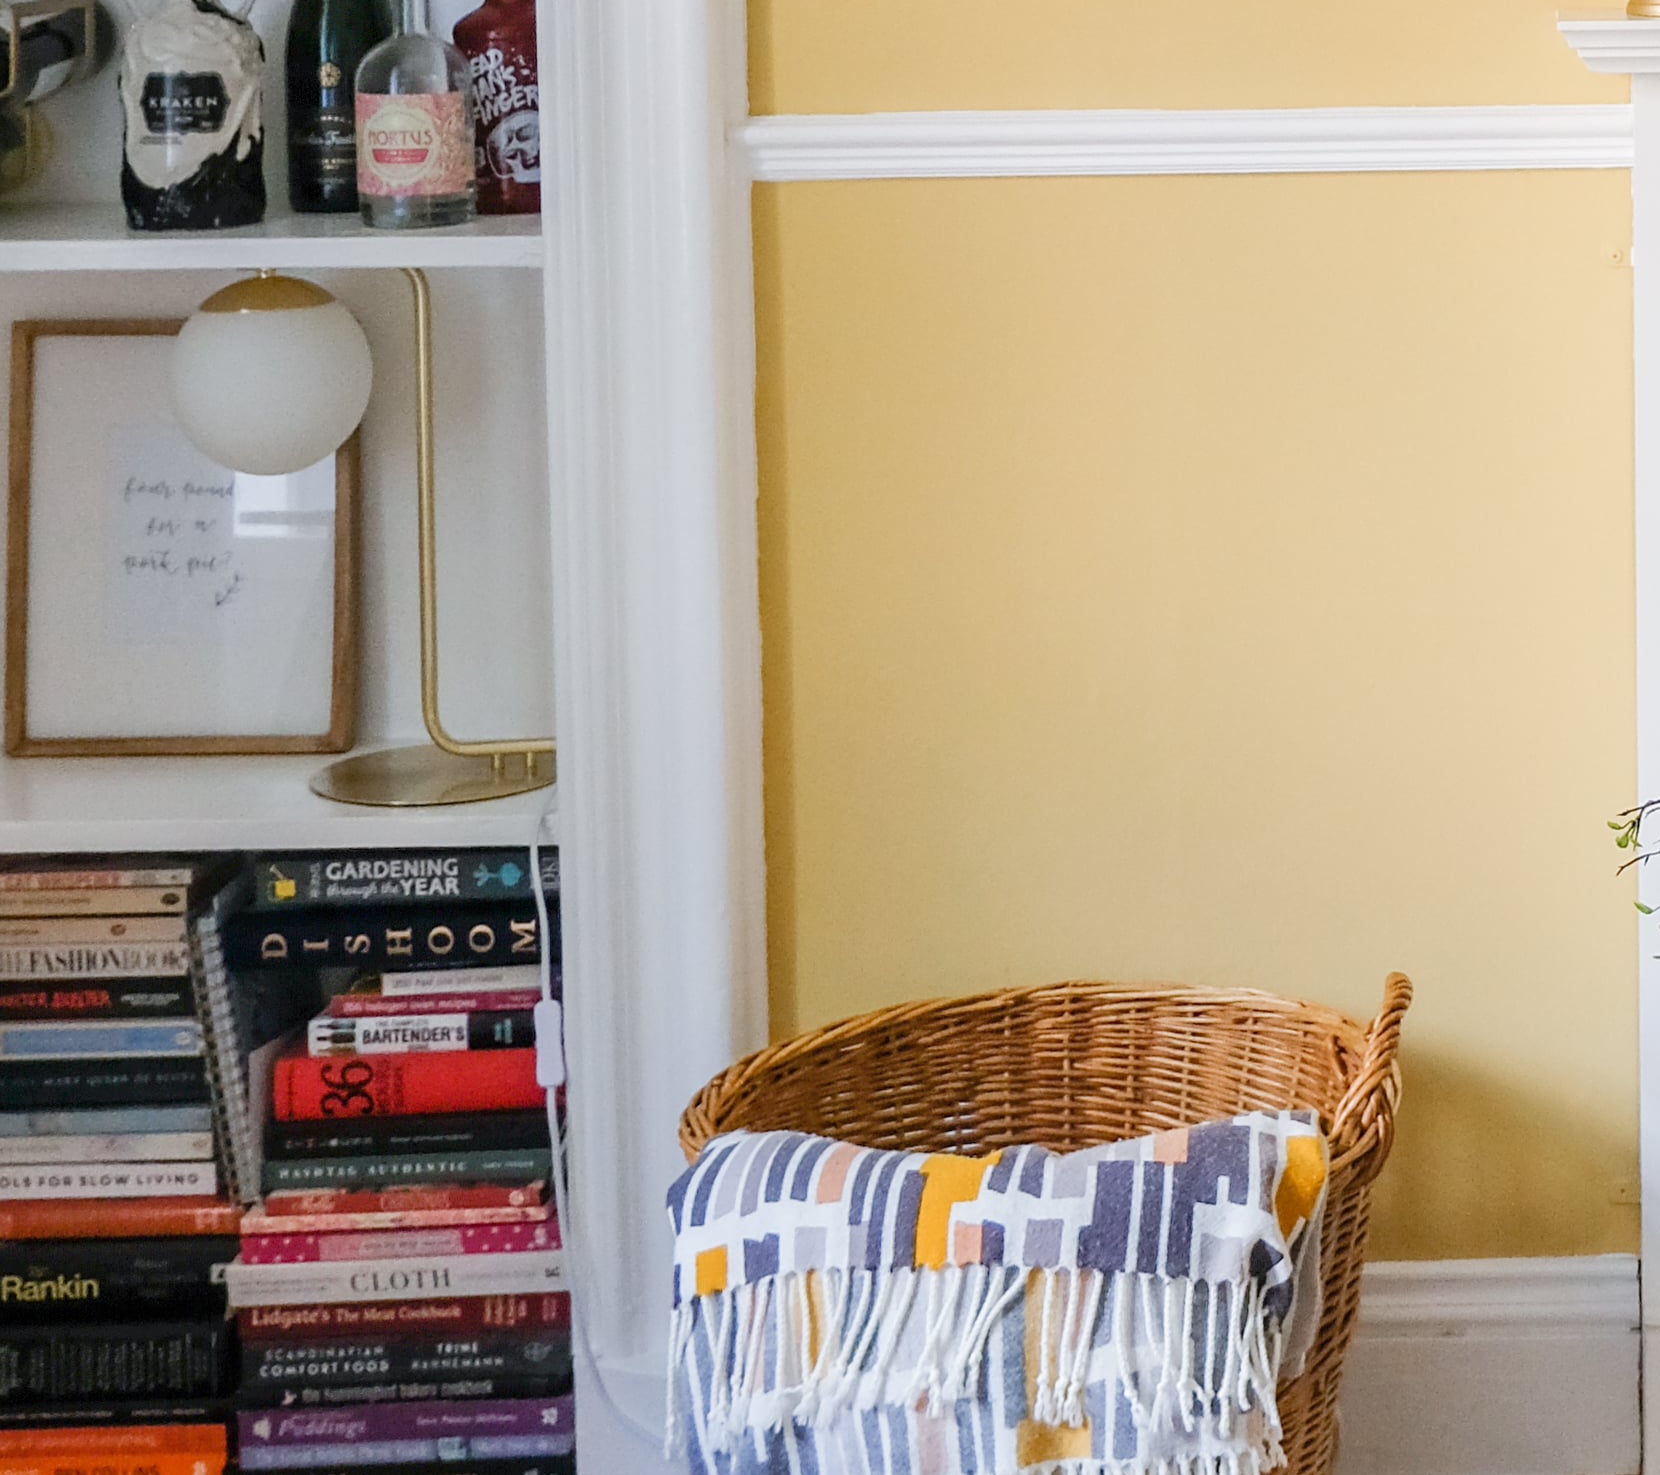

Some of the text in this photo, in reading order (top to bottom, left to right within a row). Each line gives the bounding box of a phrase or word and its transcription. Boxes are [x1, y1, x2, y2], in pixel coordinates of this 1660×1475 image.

[470, 47, 504, 75] EAD
[148, 96, 219, 109] KRAKEN
[326, 858, 460, 880] GARDENING
[326, 877, 460, 898] through the YEAR
[261, 918, 537, 960] DISHOOM
[29, 948, 120, 973] FASHION
[362, 1025, 466, 1045] BARTENDER'S
[320, 1060, 375, 1116] 36
[38, 1175, 72, 1187] FOR
[79, 1174, 130, 1187] SLOW
[136, 1172, 199, 1185] LIVING
[279, 1164, 358, 1179] HASHTAG
[368, 1161, 469, 1176] AUTHENTIC
[1, 1272, 99, 1302] Rankin
[350, 1267, 451, 1294] CLOTH
[252, 1305, 462, 1328] Lidgate's The Meat Cookbook
[265, 1346, 385, 1362] SCANDINAVIAN
[259, 1360, 390, 1378] COMFORT FOOD
[278, 1416, 367, 1439] Puddings
